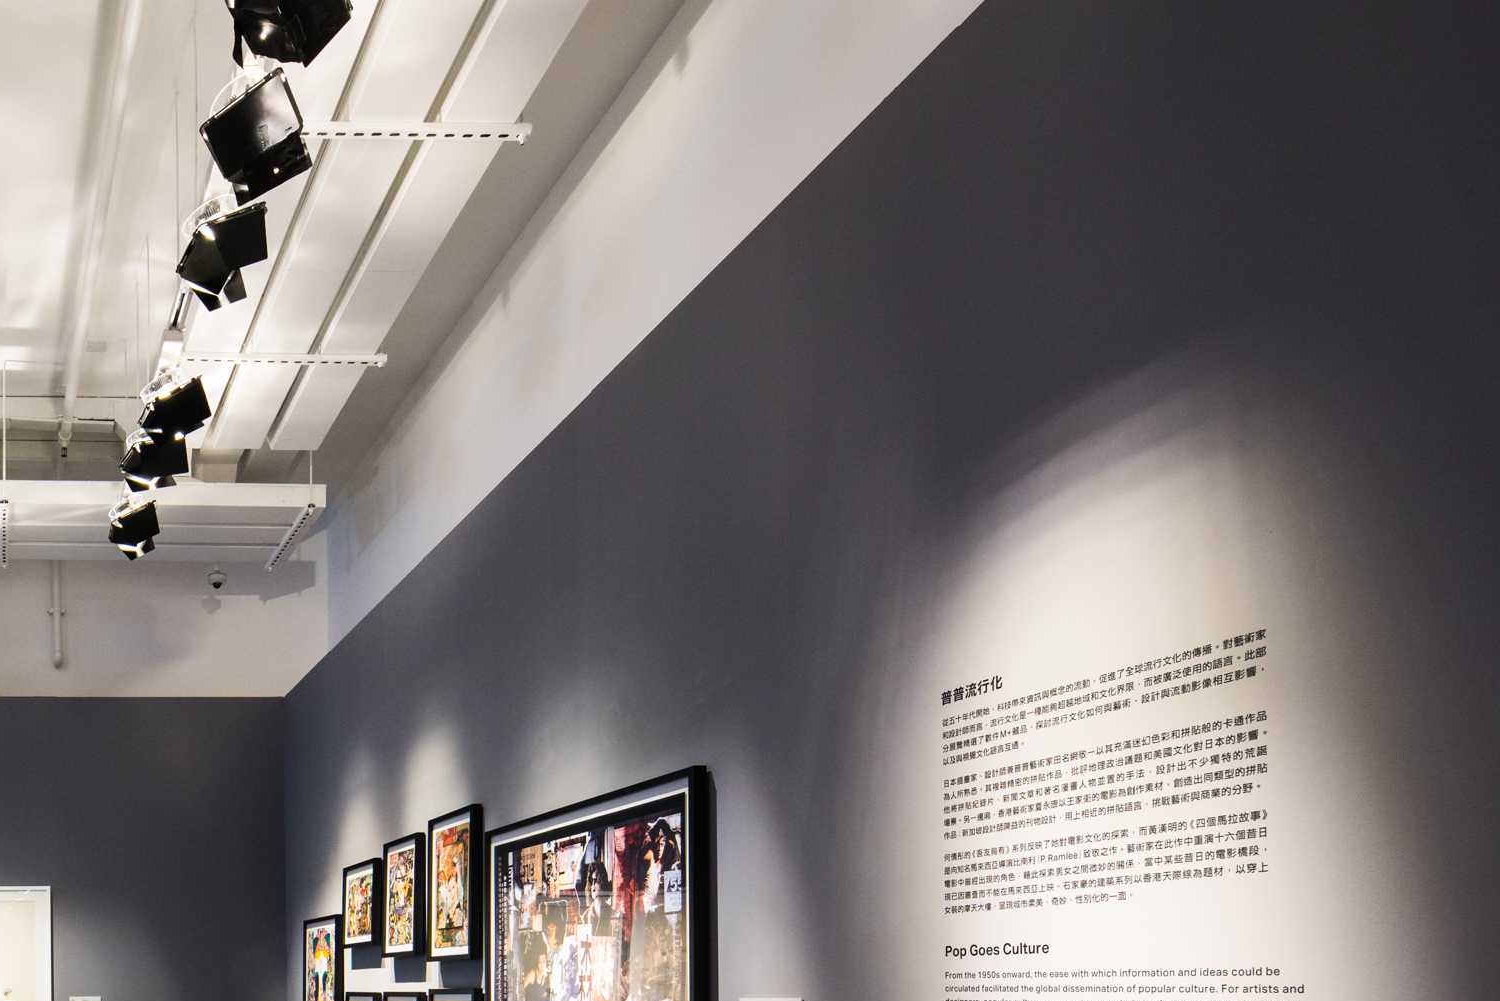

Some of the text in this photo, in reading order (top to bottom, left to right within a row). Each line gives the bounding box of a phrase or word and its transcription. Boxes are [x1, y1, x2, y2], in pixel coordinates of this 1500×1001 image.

[941, 674, 1003, 707] 普普流行化
[945, 941, 1049, 959] Pop Goes Culture
[945, 971, 963, 979] From
[964, 971, 976, 979] the
[978, 970, 1000, 979] 1950s
[1034, 969, 1047, 978] the
[1071, 969, 1089, 978] with
[1091, 968, 1117, 978] which
[1120, 967, 1175, 977] information
[1178, 967, 1197, 977] and
[1200, 966, 1228, 977] ideas
[1231, 966, 1262, 976] could
[1266, 965, 1280, 976] be
[945, 984, 980, 992] circulated
[981, 984, 1019, 993] facilitated
[1021, 984, 1034, 993] the
[1035, 984, 1060, 995] global
[1062, 984, 1124, 993] dissemination
[1126, 984, 1136, 993] of
[1138, 984, 1175, 996] popular
[1221, 983, 1239, 993] For
[1242, 983, 1279, 994] artists
[1282, 983, 1305, 994] and
